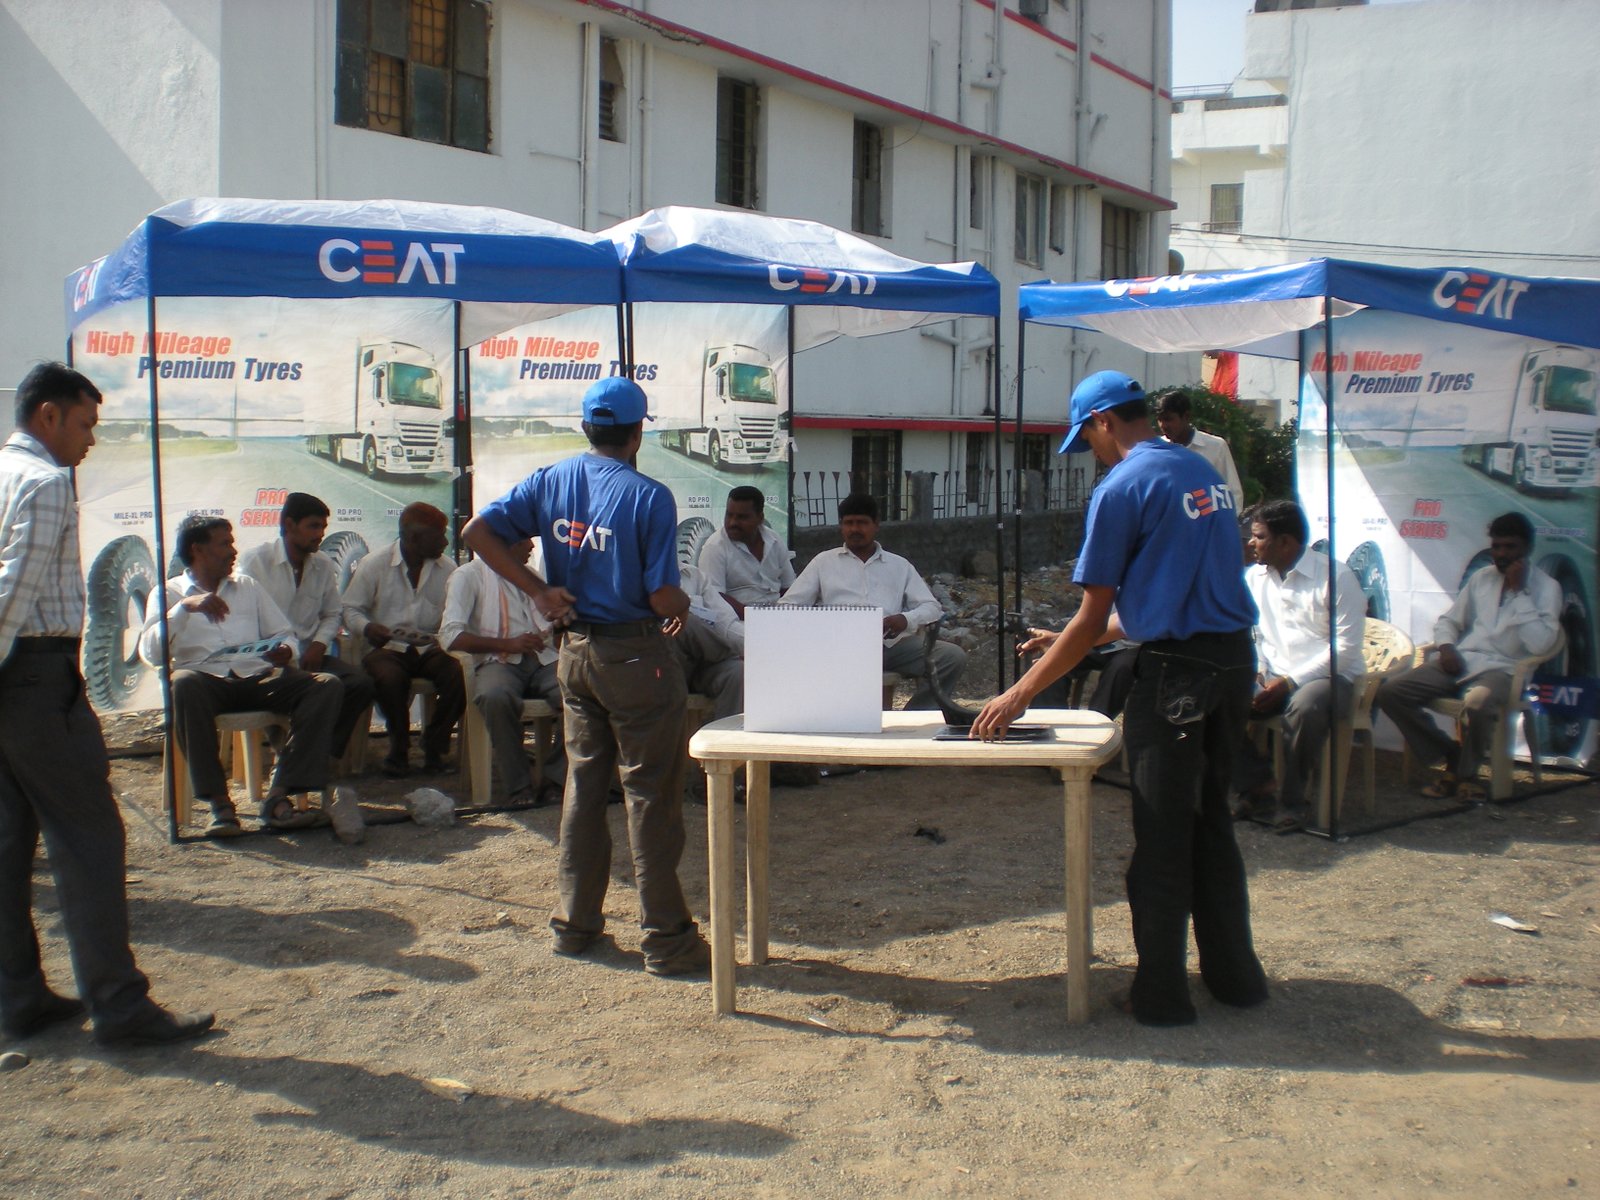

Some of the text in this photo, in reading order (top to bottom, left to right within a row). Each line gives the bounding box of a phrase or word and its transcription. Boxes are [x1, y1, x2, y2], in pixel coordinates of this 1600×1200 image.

[318, 238, 467, 286] CEAT
[768, 263, 877, 295] CEAT
[1433, 270, 1531, 320] CEAT
[85, 331, 232, 358] High Mileage
[479, 335, 600, 361] High Mileage
[244, 357, 303, 382] Tyres
[519, 359, 658, 381] Premium Tes
[1353, 351, 1424, 374] Mileage
[1345, 371, 1475, 394] Premium Tyres
[255, 488, 289, 507] PRO
[1183, 483, 1233, 520] CEAT
[139, 511, 153, 519] PRO
[239, 508, 282, 527] SERI
[348, 508, 362, 516] PRO
[552, 518, 613, 552] CEAT
[1399, 519, 1449, 540] SERIES
[1526, 683, 1584, 706] CEAT
